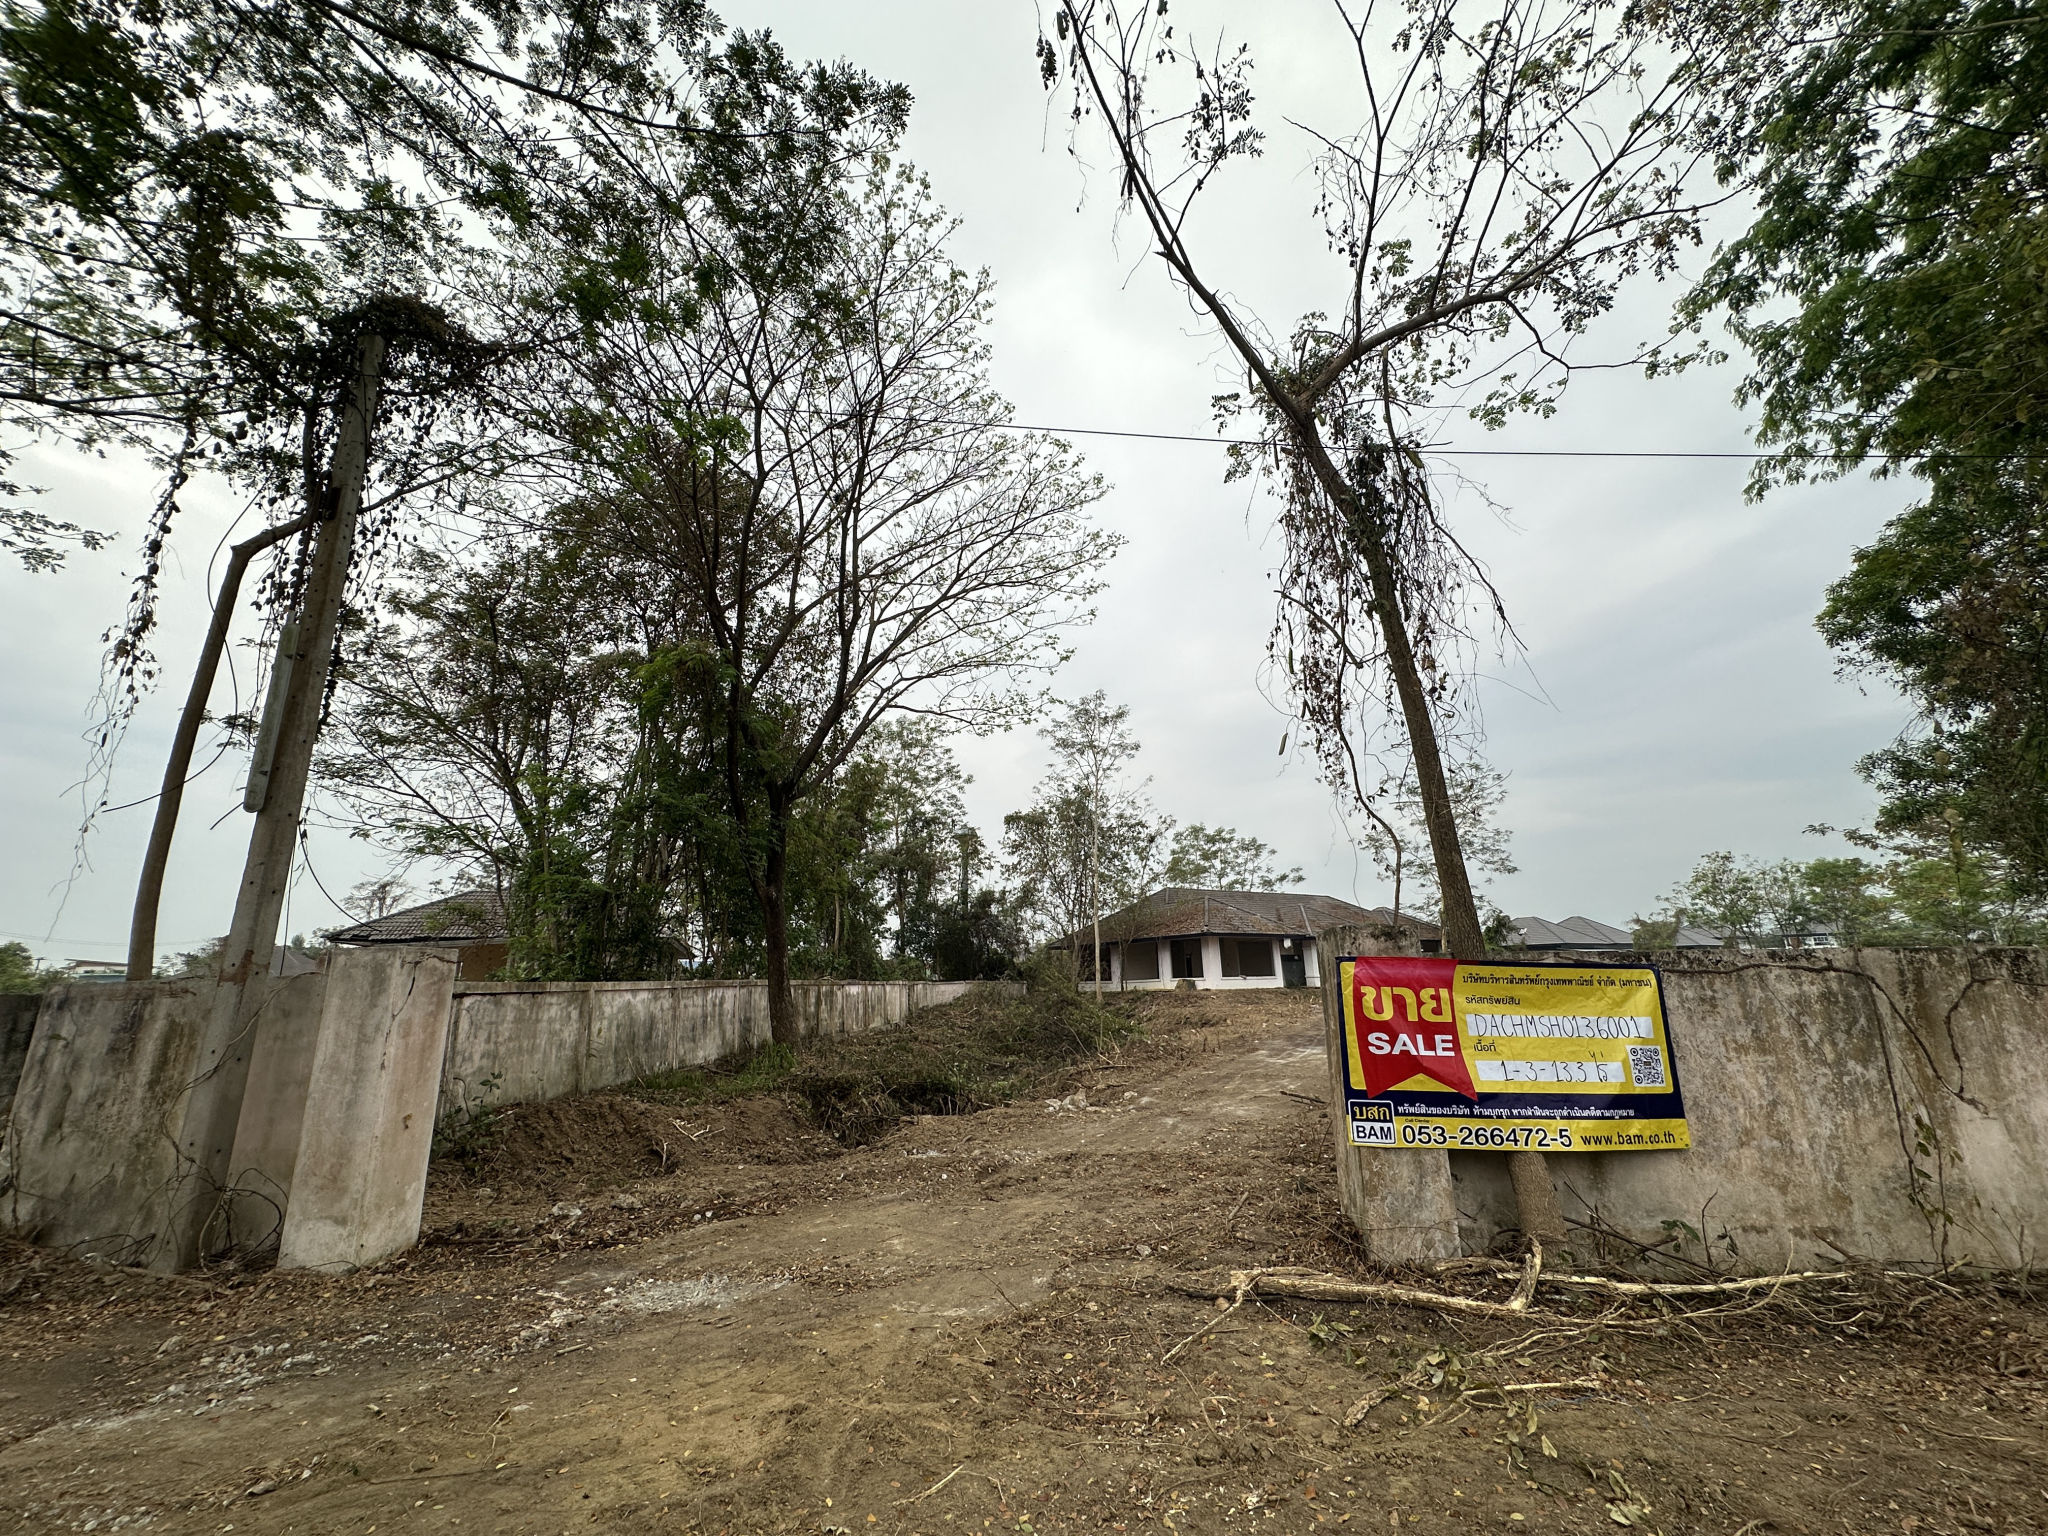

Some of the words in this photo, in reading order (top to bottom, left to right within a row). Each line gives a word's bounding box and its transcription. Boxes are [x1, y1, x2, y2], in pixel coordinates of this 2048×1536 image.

[1597, 976, 1616, 988] จำกัด
[1360, 985, 1453, 1022] ขาย
[1465, 994, 1521, 1006] รหัสทรัพย์สิน
[1367, 1032, 1455, 1057] SALE
[1473, 1039, 1497, 1053] เนื้อที่
[1353, 1105, 1390, 1121] บสก
[1397, 1103, 1470, 1115] ทรัพย์สินของบริษัท
[1473, 1107, 1510, 1120] ห้ามบุกรุก
[1355, 1125, 1393, 1141] BAM
[1402, 1124, 1573, 1148] 053-266472-5
[1581, 1131, 1676, 1146] www.bam.co.th
